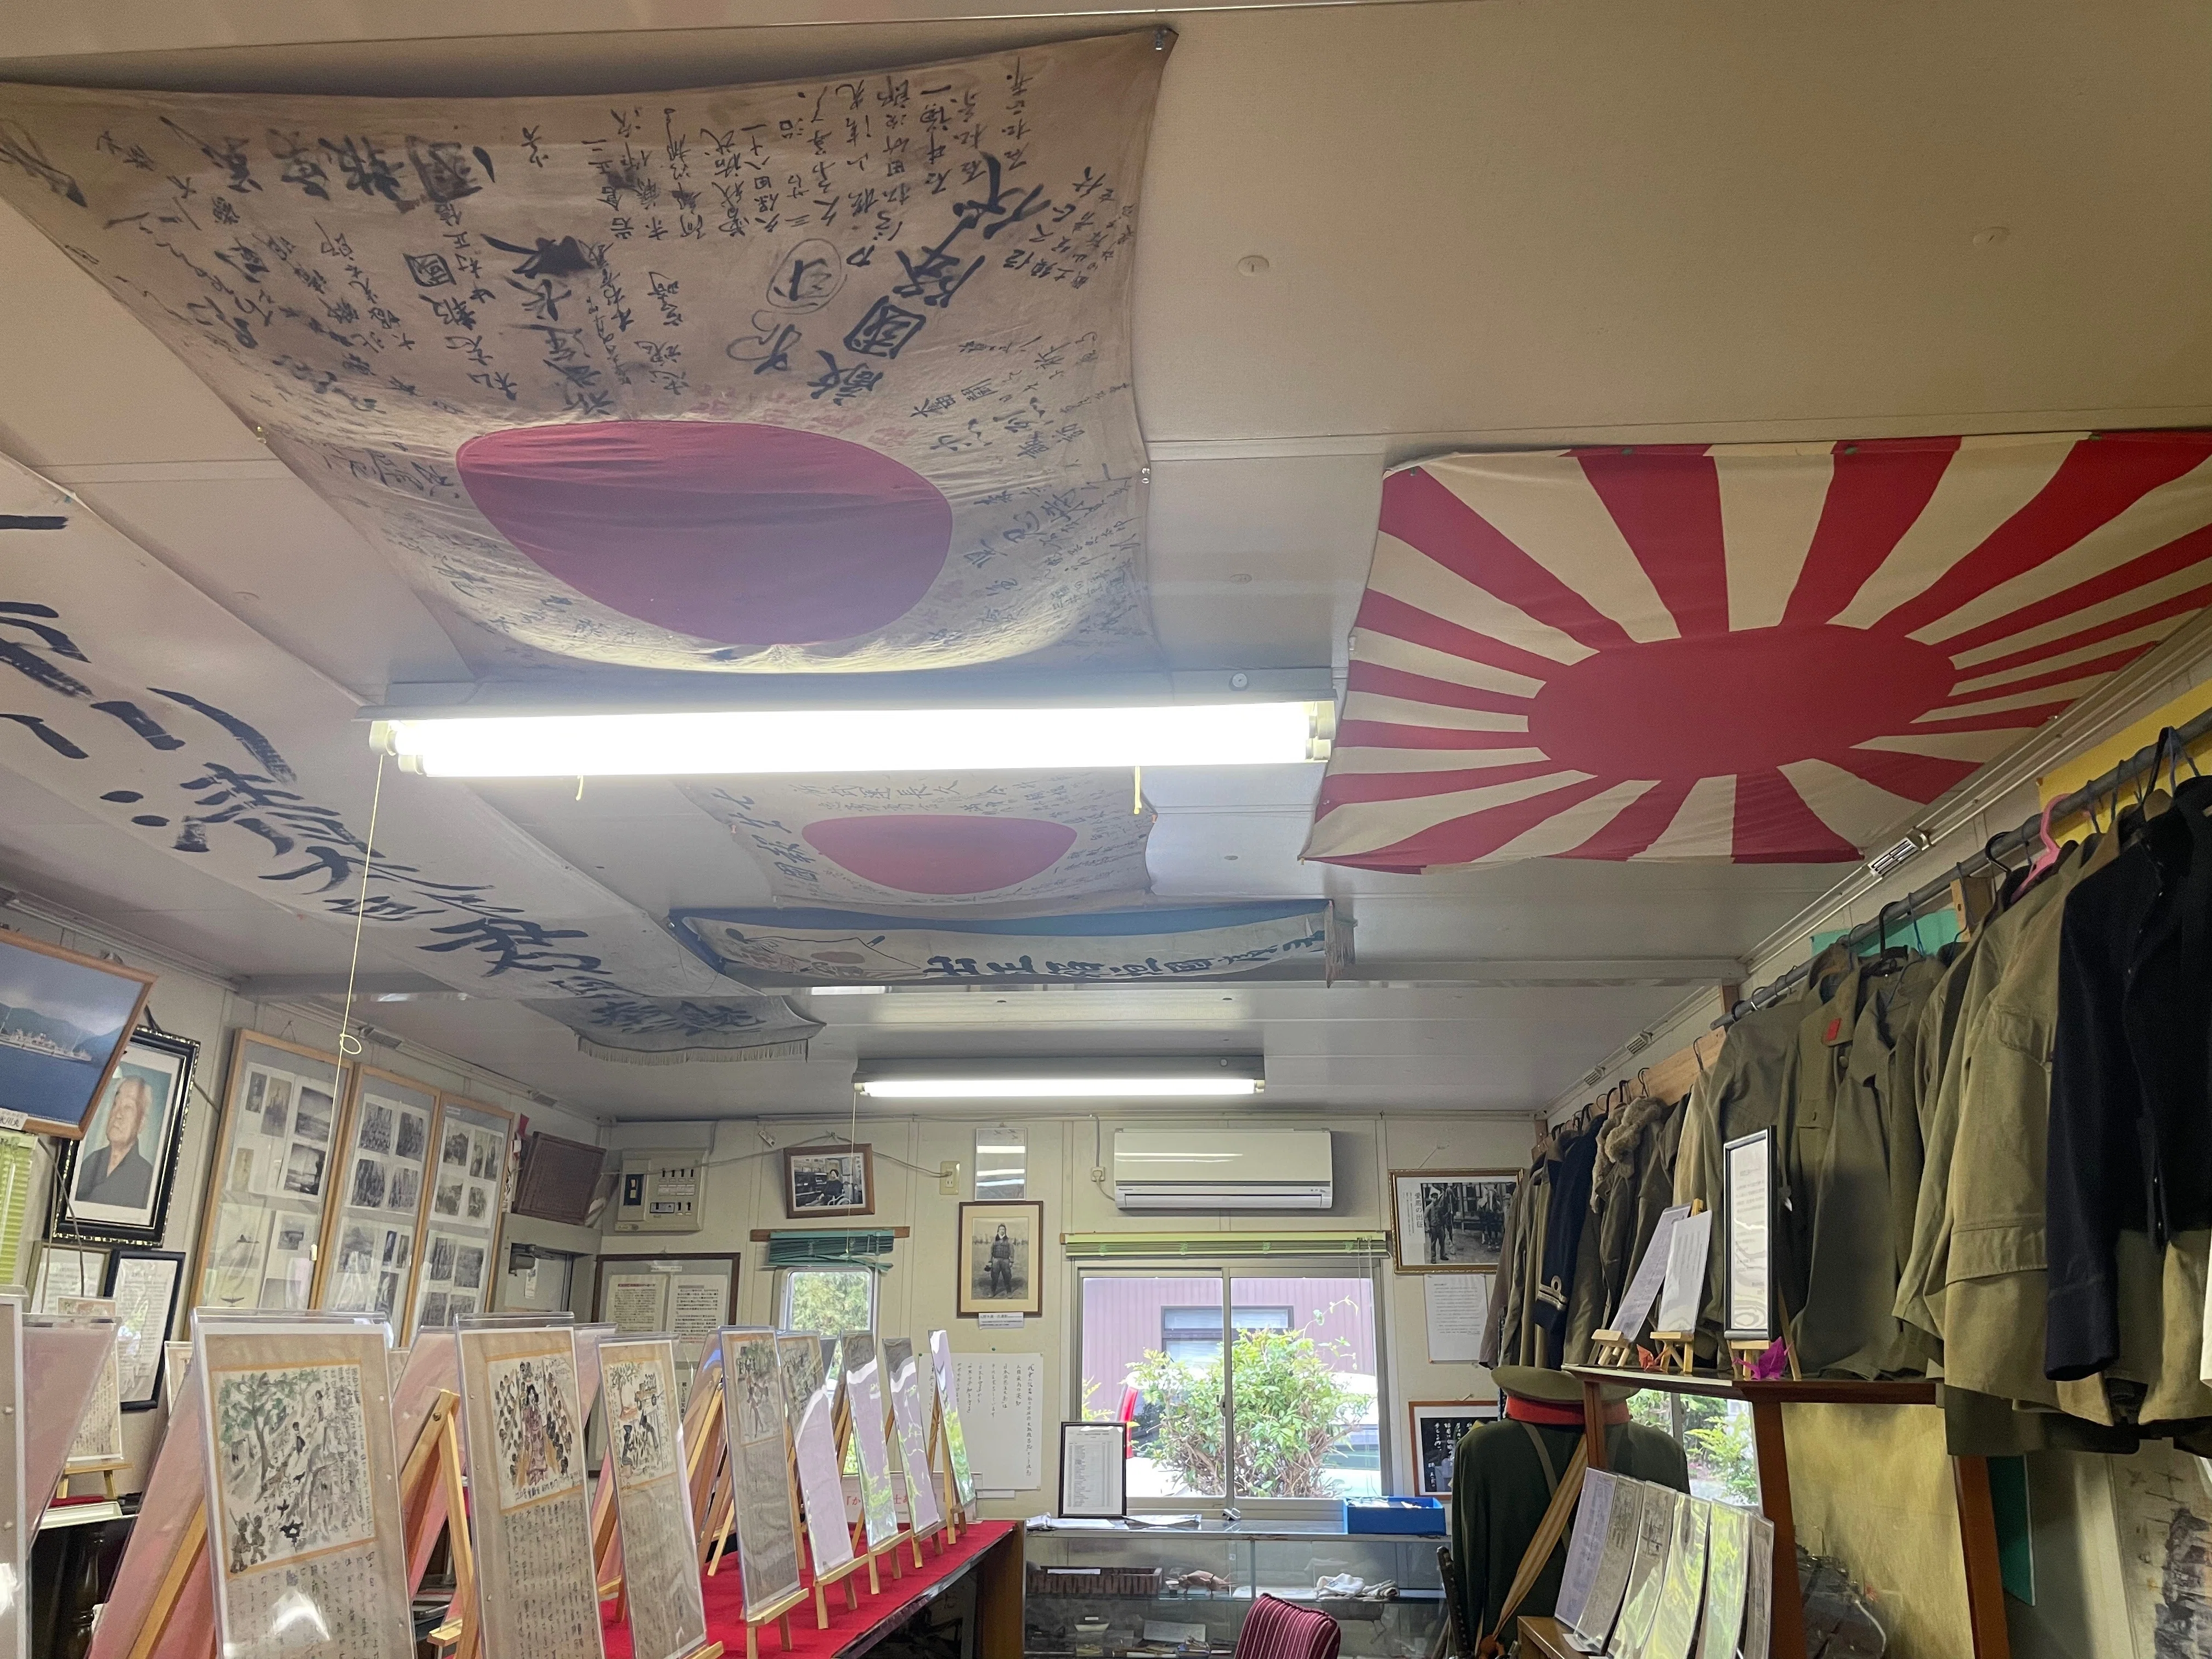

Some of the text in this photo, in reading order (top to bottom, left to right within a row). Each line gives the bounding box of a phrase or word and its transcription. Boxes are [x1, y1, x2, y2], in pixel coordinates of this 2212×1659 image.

[1415, 1192, 1424, 1228] 愛馬の出征
